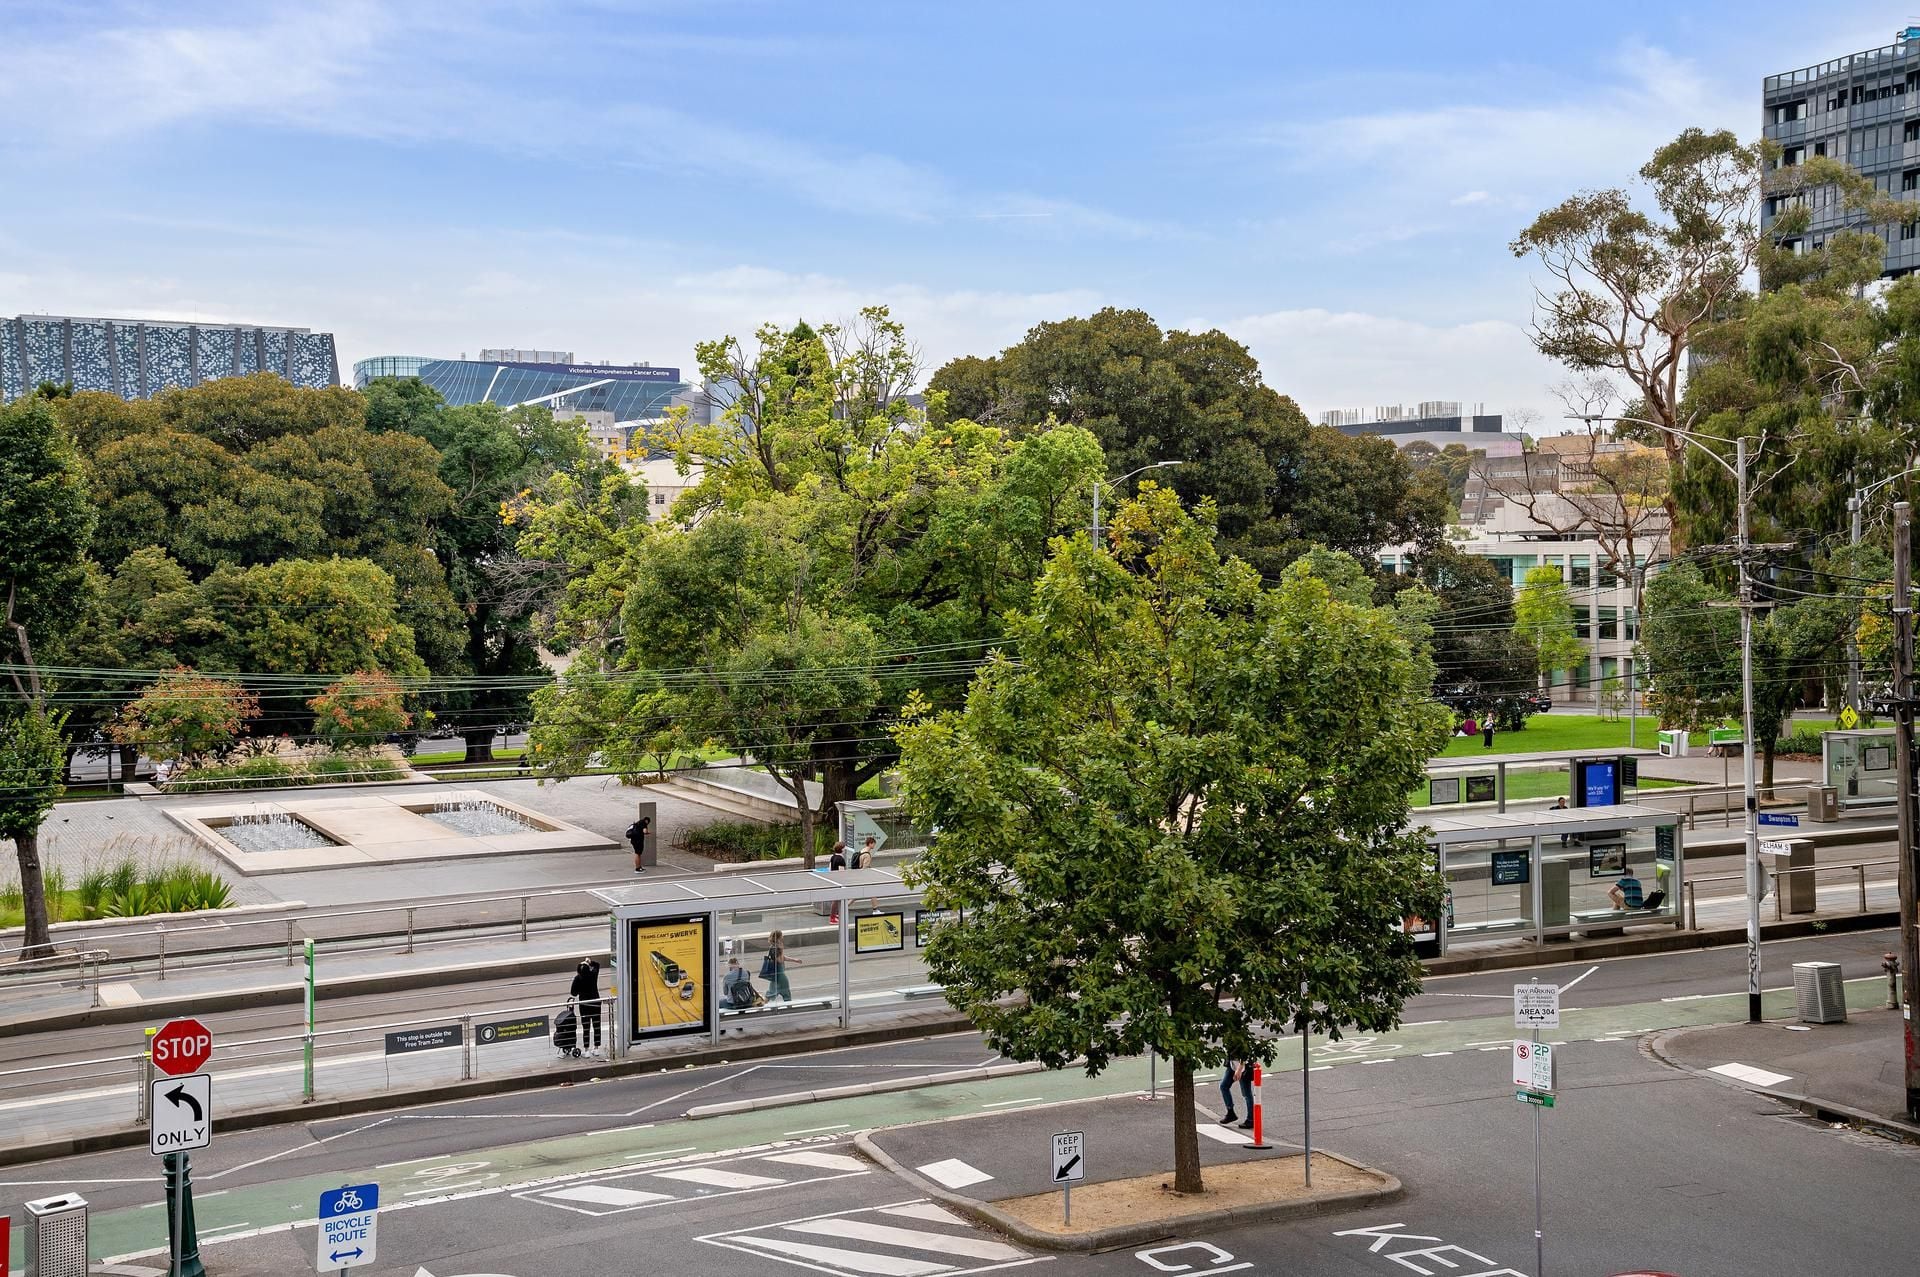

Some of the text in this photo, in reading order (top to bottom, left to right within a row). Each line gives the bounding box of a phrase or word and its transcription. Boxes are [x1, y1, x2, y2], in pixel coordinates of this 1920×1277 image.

[593, 368, 633, 376] Comprehensive
[1759, 841, 1783, 850] PELHAM
[670, 929, 698, 938] SWERVE
[156, 1035, 209, 1060] STOP
[417, 1039, 433, 1047] Tram
[1534, 1044, 1549, 1056] 2P
[157, 1127, 205, 1146] ONLY
[1057, 1135, 1079, 1146] KEEP
[1058, 1146, 1078, 1156] LEFT
[325, 1215, 372, 1233] BICYCLE
[328, 1228, 367, 1244] ROUTE
